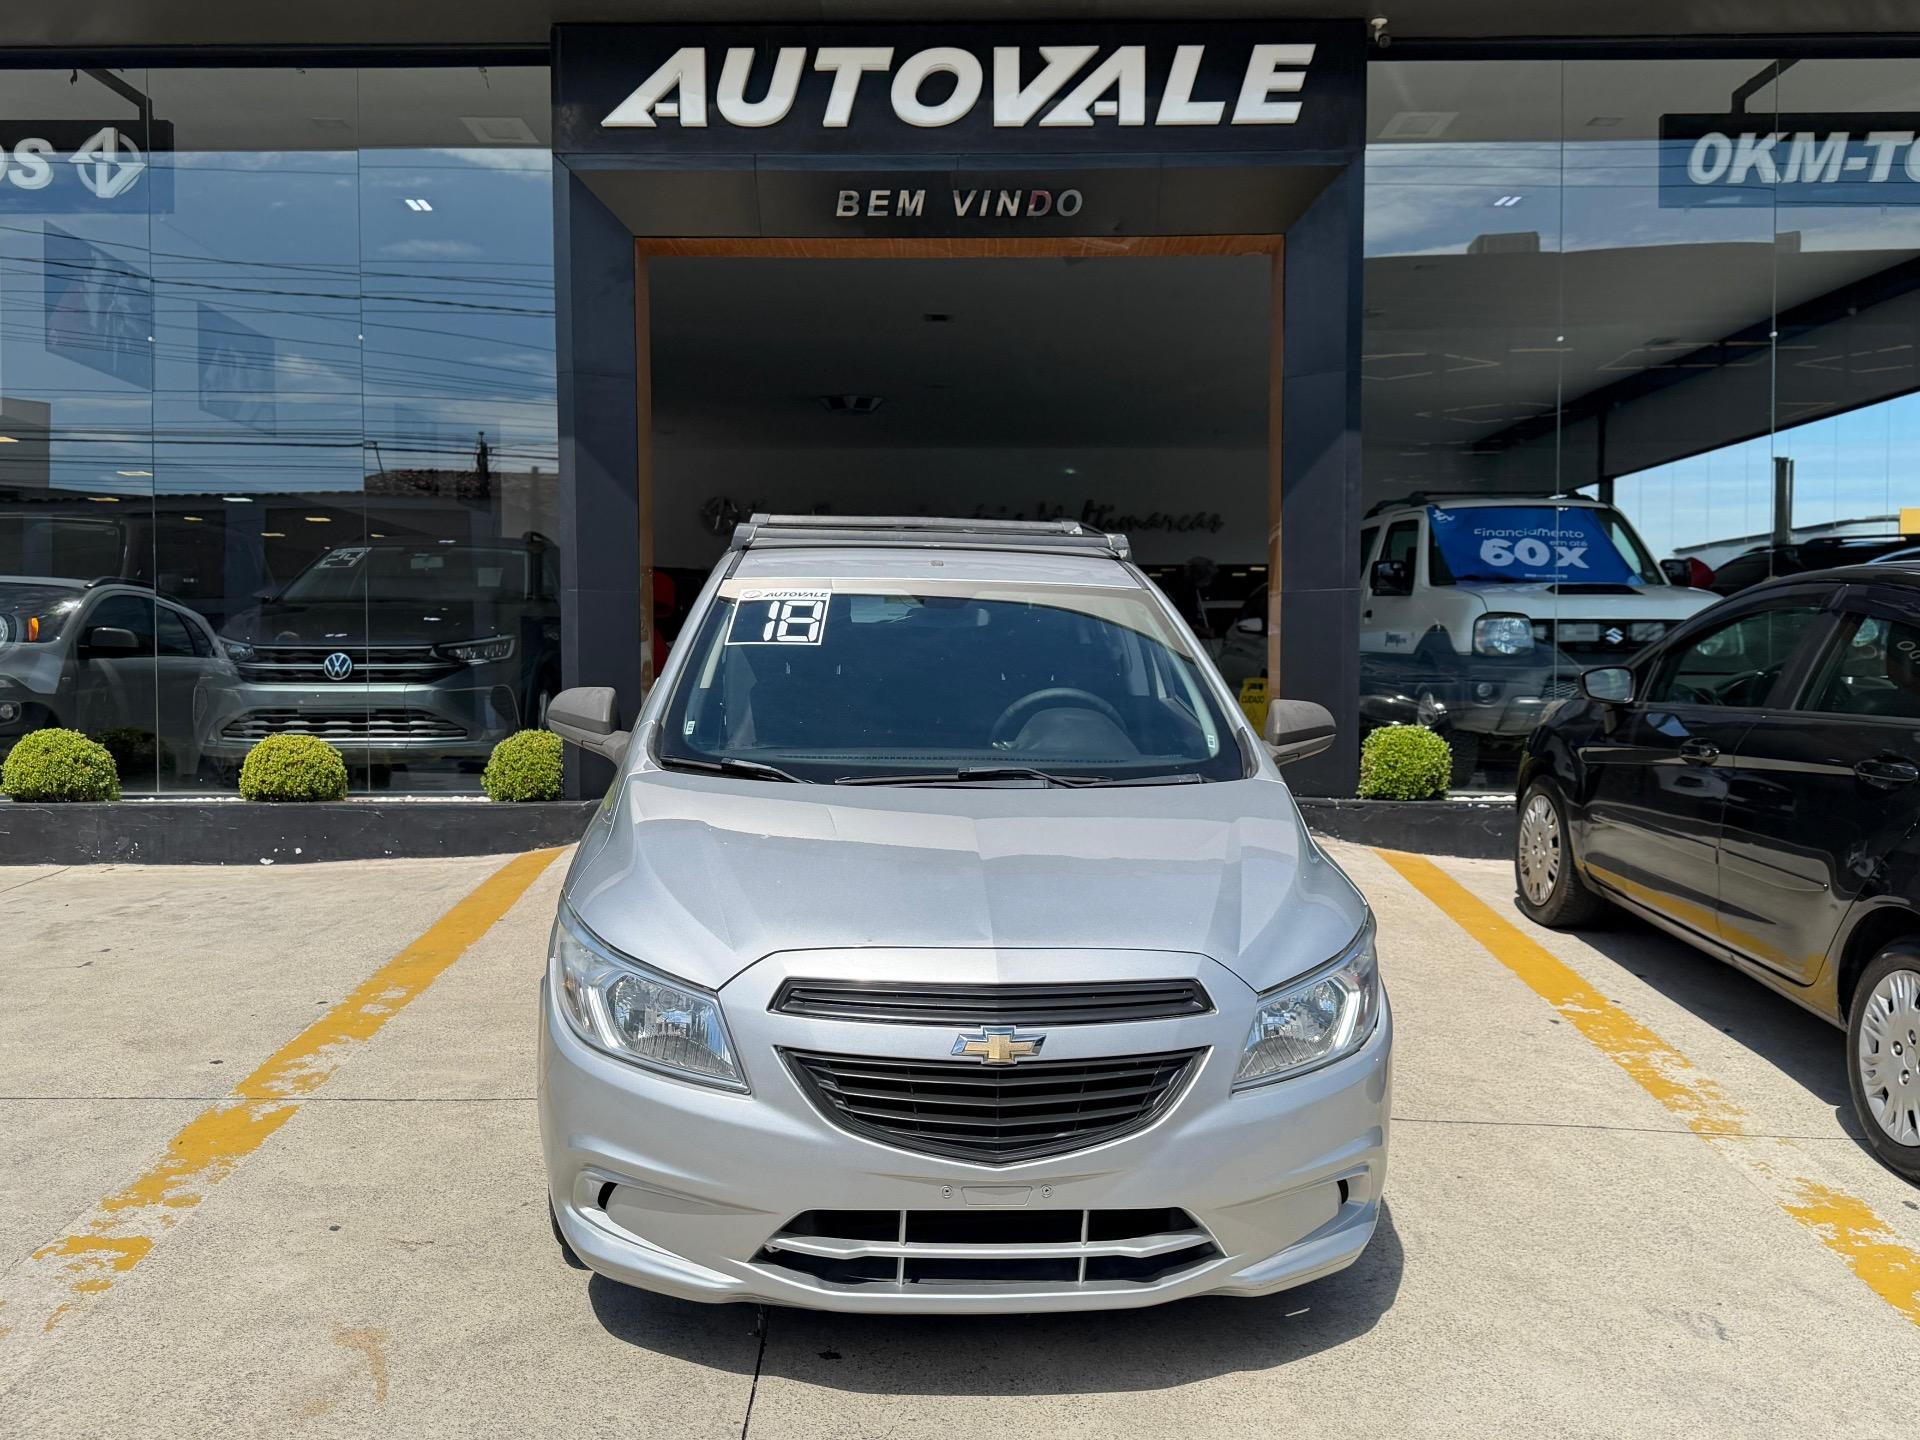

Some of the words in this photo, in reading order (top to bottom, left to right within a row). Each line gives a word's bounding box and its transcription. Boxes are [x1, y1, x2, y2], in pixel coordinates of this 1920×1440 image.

[601, 44, 1316, 127] AUTOVALE
[836, 189, 926, 217] BEM
[953, 189, 1083, 217] VINDO
[1474, 528, 1584, 538] Financiamento
[763, 600, 824, 642] 18
